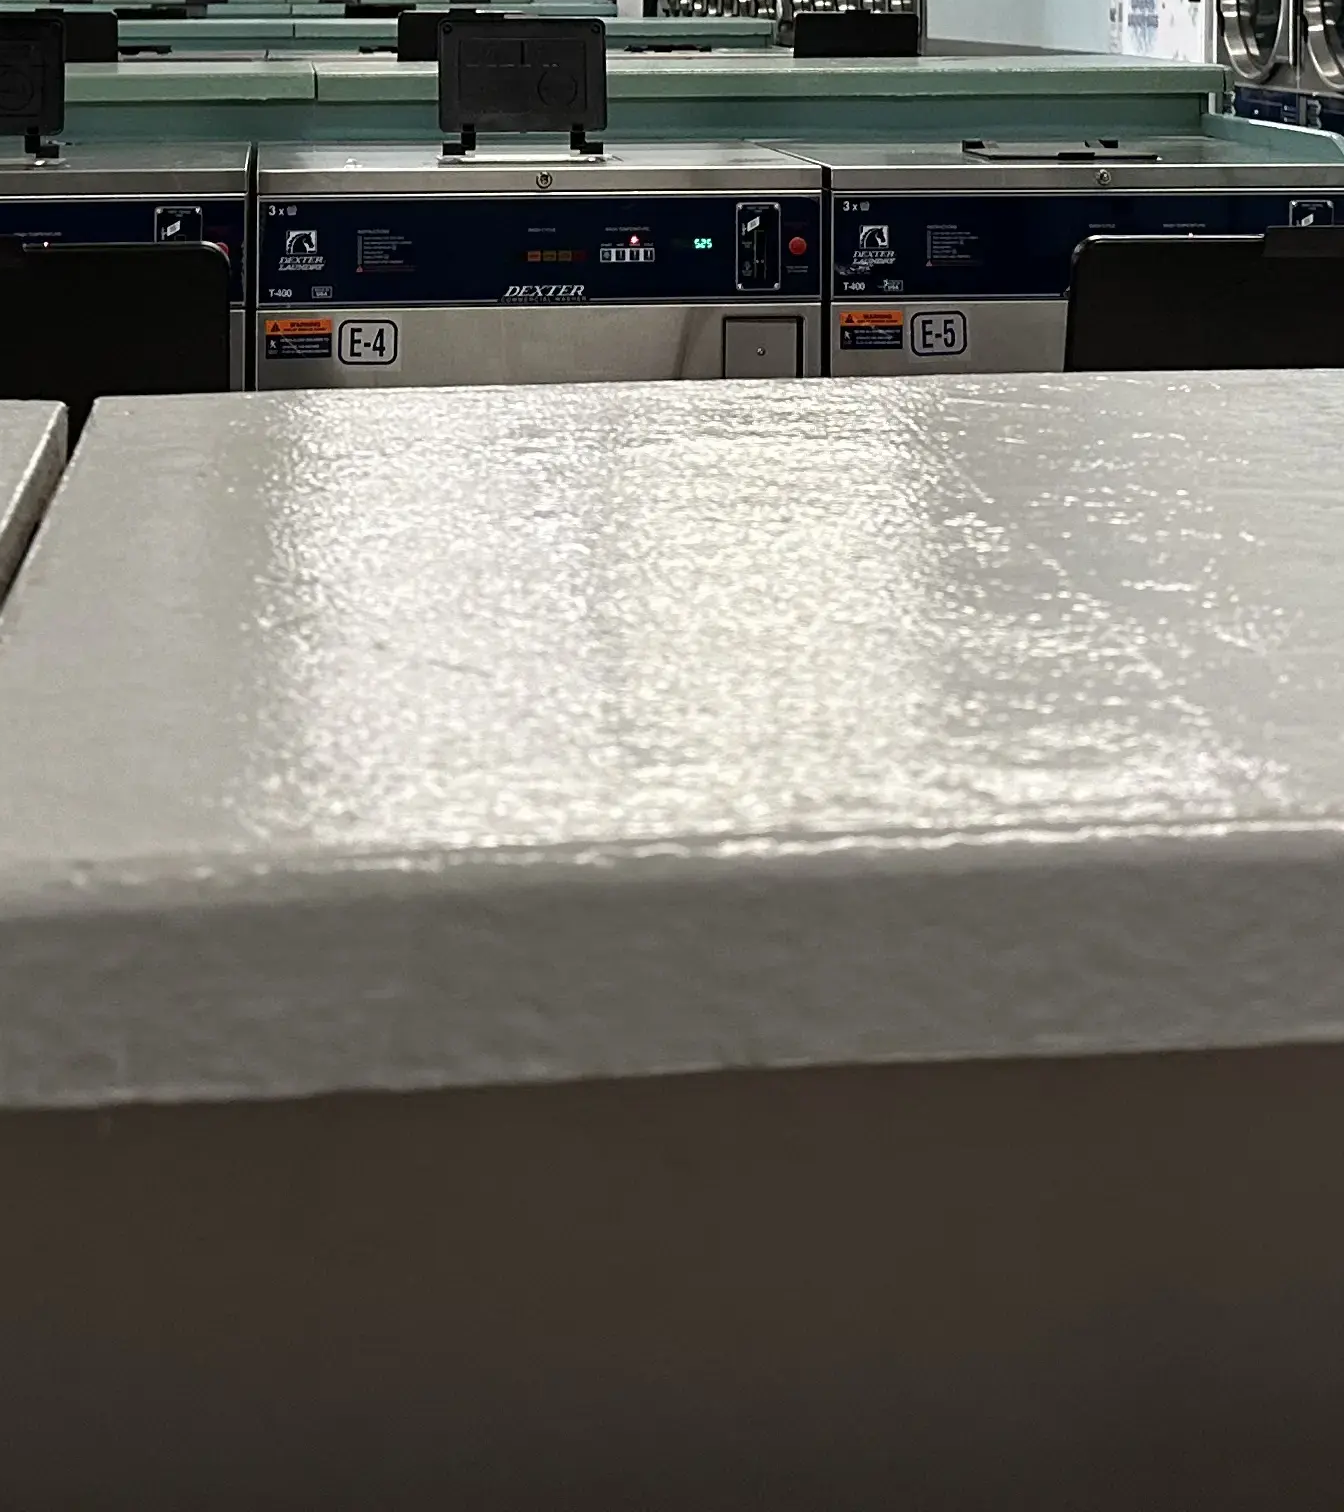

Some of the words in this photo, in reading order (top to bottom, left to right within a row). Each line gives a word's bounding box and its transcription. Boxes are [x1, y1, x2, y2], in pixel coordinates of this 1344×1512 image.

[268, 205, 276, 216] 3
[842, 200, 850, 211] 3
[853, 250, 895, 258] DEXTER
[278, 256, 324, 264] DEXTER
[504, 284, 586, 297] DEXTER
[921, 318, 956, 349] E-5
[349, 327, 386, 357] E-4
